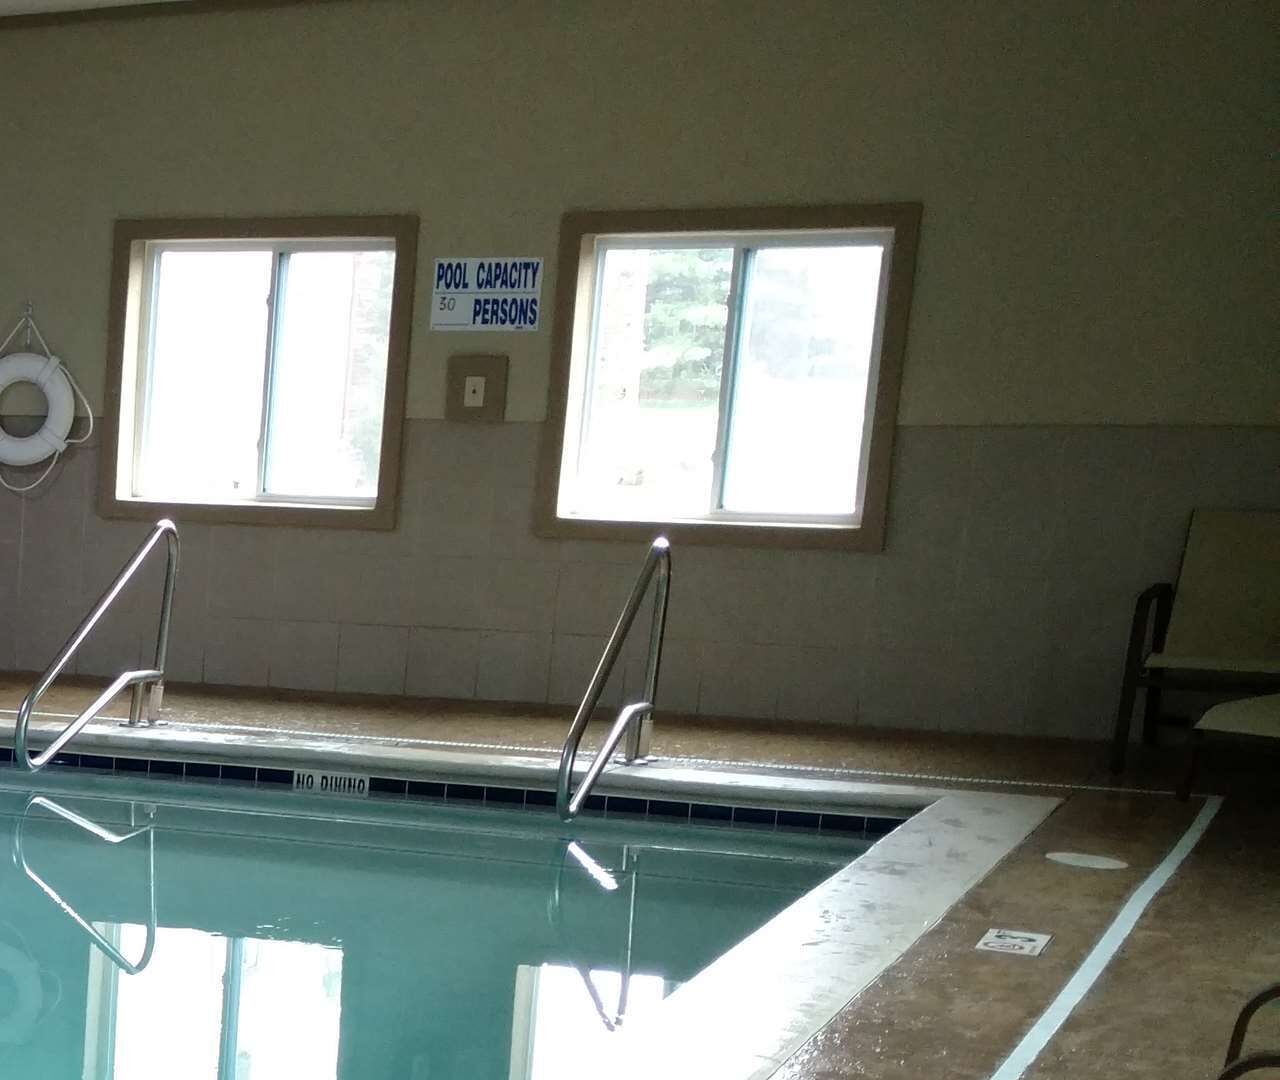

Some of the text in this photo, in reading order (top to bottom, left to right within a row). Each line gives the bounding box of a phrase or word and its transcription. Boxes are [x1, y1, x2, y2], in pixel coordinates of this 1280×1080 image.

[435, 262, 540, 290] POOL CAPACITY
[472, 298, 538, 325] PERSONS
[297, 773, 314, 789] NO
